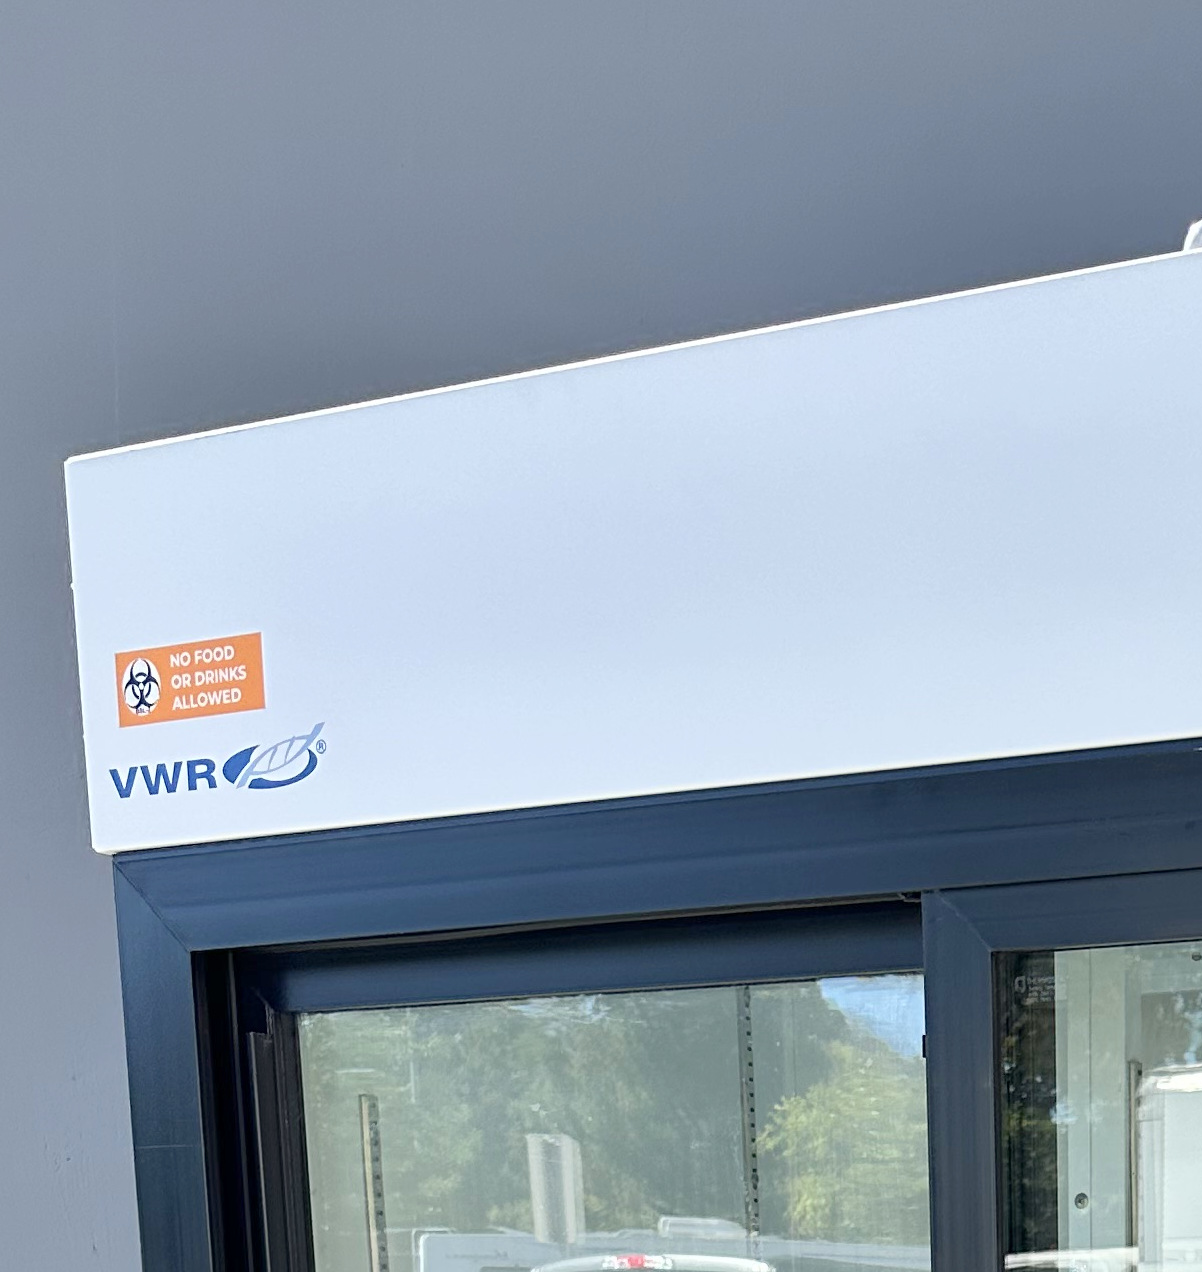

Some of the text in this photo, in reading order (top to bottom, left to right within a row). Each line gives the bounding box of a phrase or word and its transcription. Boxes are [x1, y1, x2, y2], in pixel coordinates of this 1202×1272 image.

[169, 645, 235, 668] NO FOOD
[171, 665, 247, 689] OR DRINKS
[172, 687, 242, 711] ALLOWED
[109, 758, 217, 799] VWR
